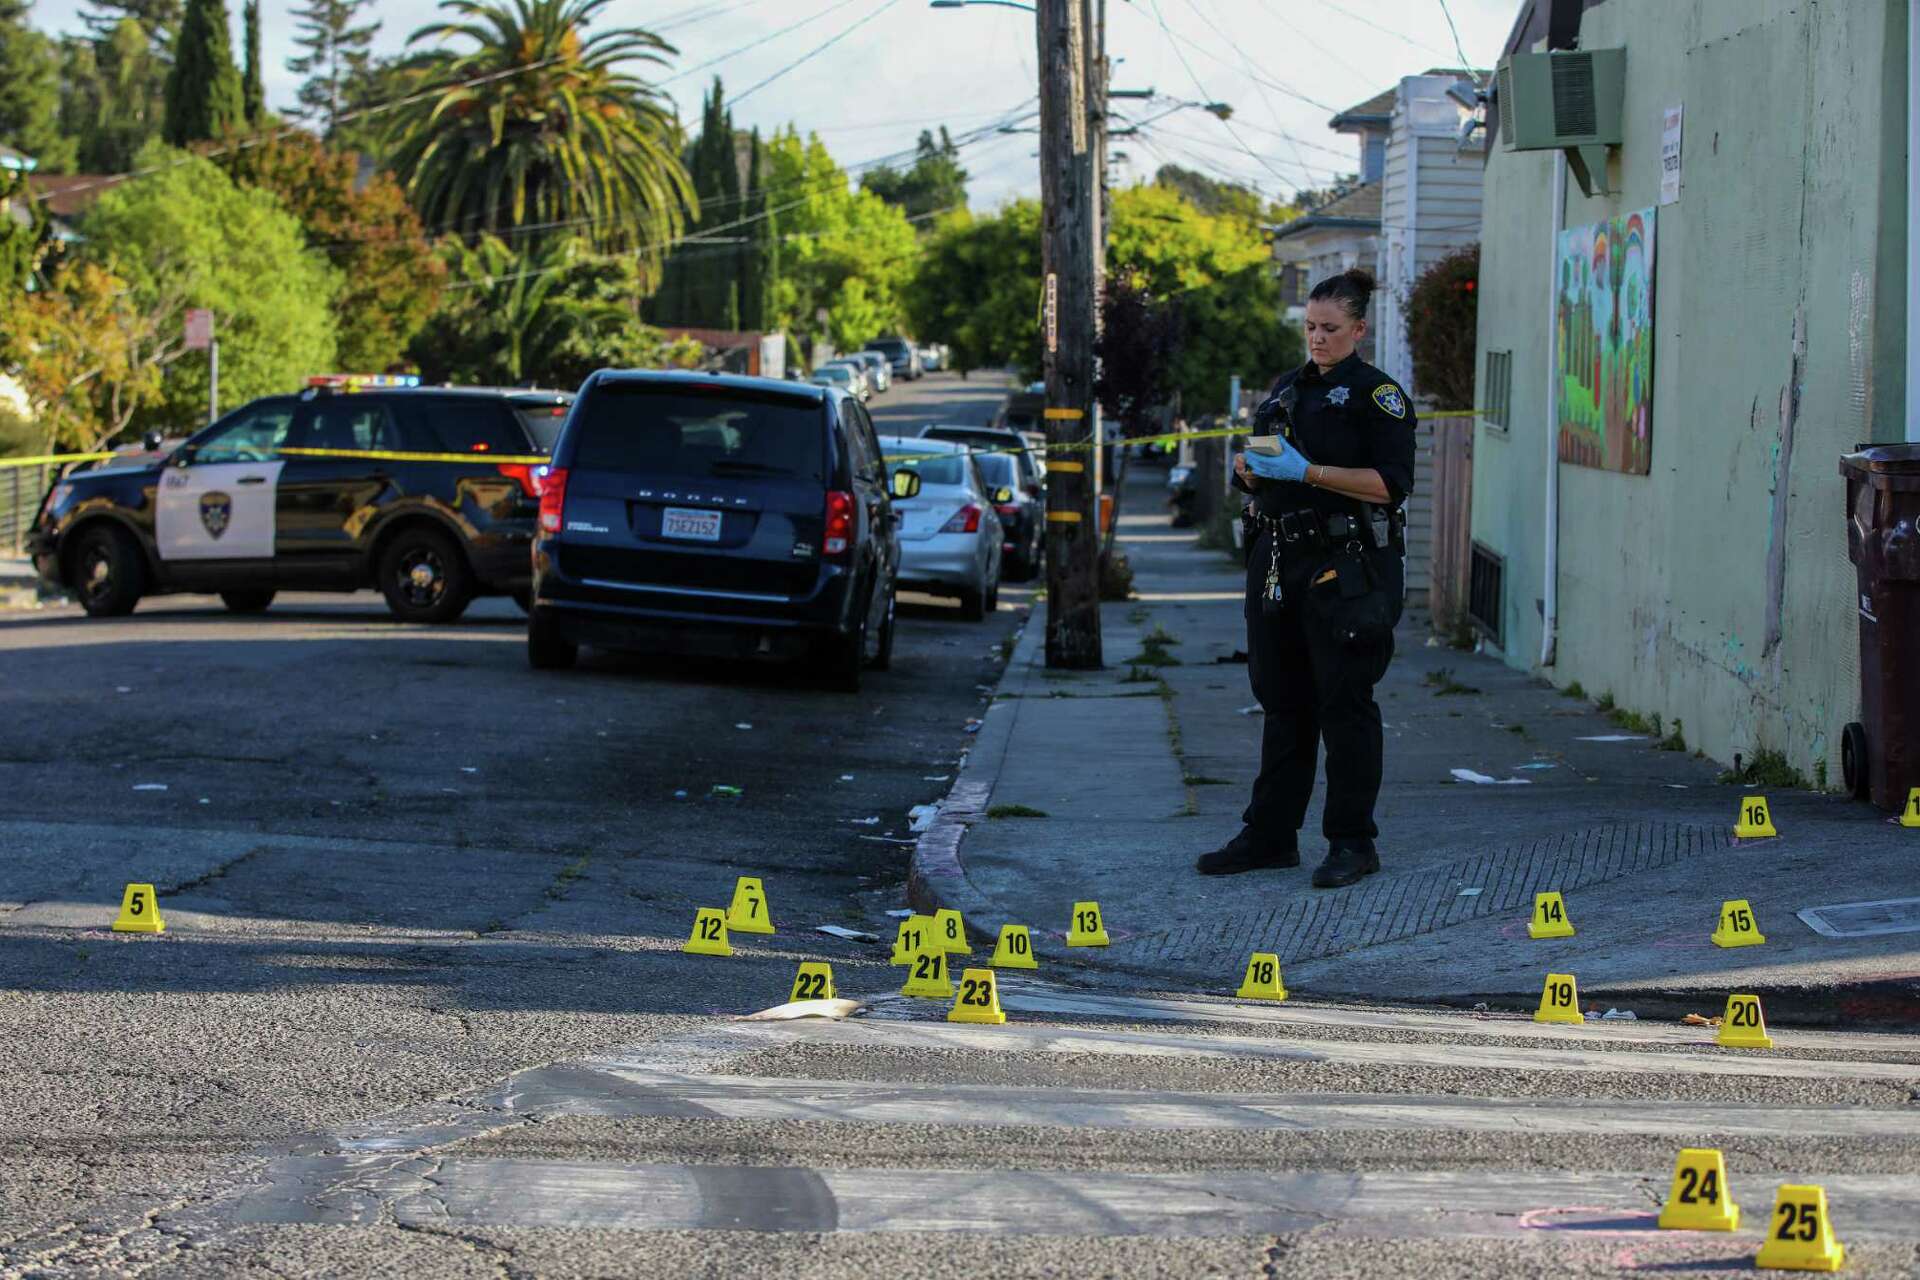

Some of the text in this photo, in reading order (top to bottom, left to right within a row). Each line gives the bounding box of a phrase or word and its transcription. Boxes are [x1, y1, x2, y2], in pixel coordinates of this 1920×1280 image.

[1745, 805, 1766, 826] 16
[1911, 795, 1920, 816] 1
[130, 892, 145, 916] 5
[748, 897, 760, 919] 7
[1540, 900, 1563, 924] 14
[699, 916, 722, 941] 12
[946, 917, 957, 940] 8
[1076, 910, 1098, 934] 13
[1727, 909, 1751, 933] 15
[901, 929, 921, 952] 11
[1005, 932, 1028, 955] 10
[914, 953, 942, 980] 21
[1251, 960, 1274, 985] 18
[795, 972, 826, 1000] 22
[961, 979, 992, 1007] 23
[1548, 982, 1573, 1008] 19
[1731, 1000, 1760, 1028] 20
[1679, 1167, 1719, 1205] 24
[1776, 1202, 1818, 1243] 25
